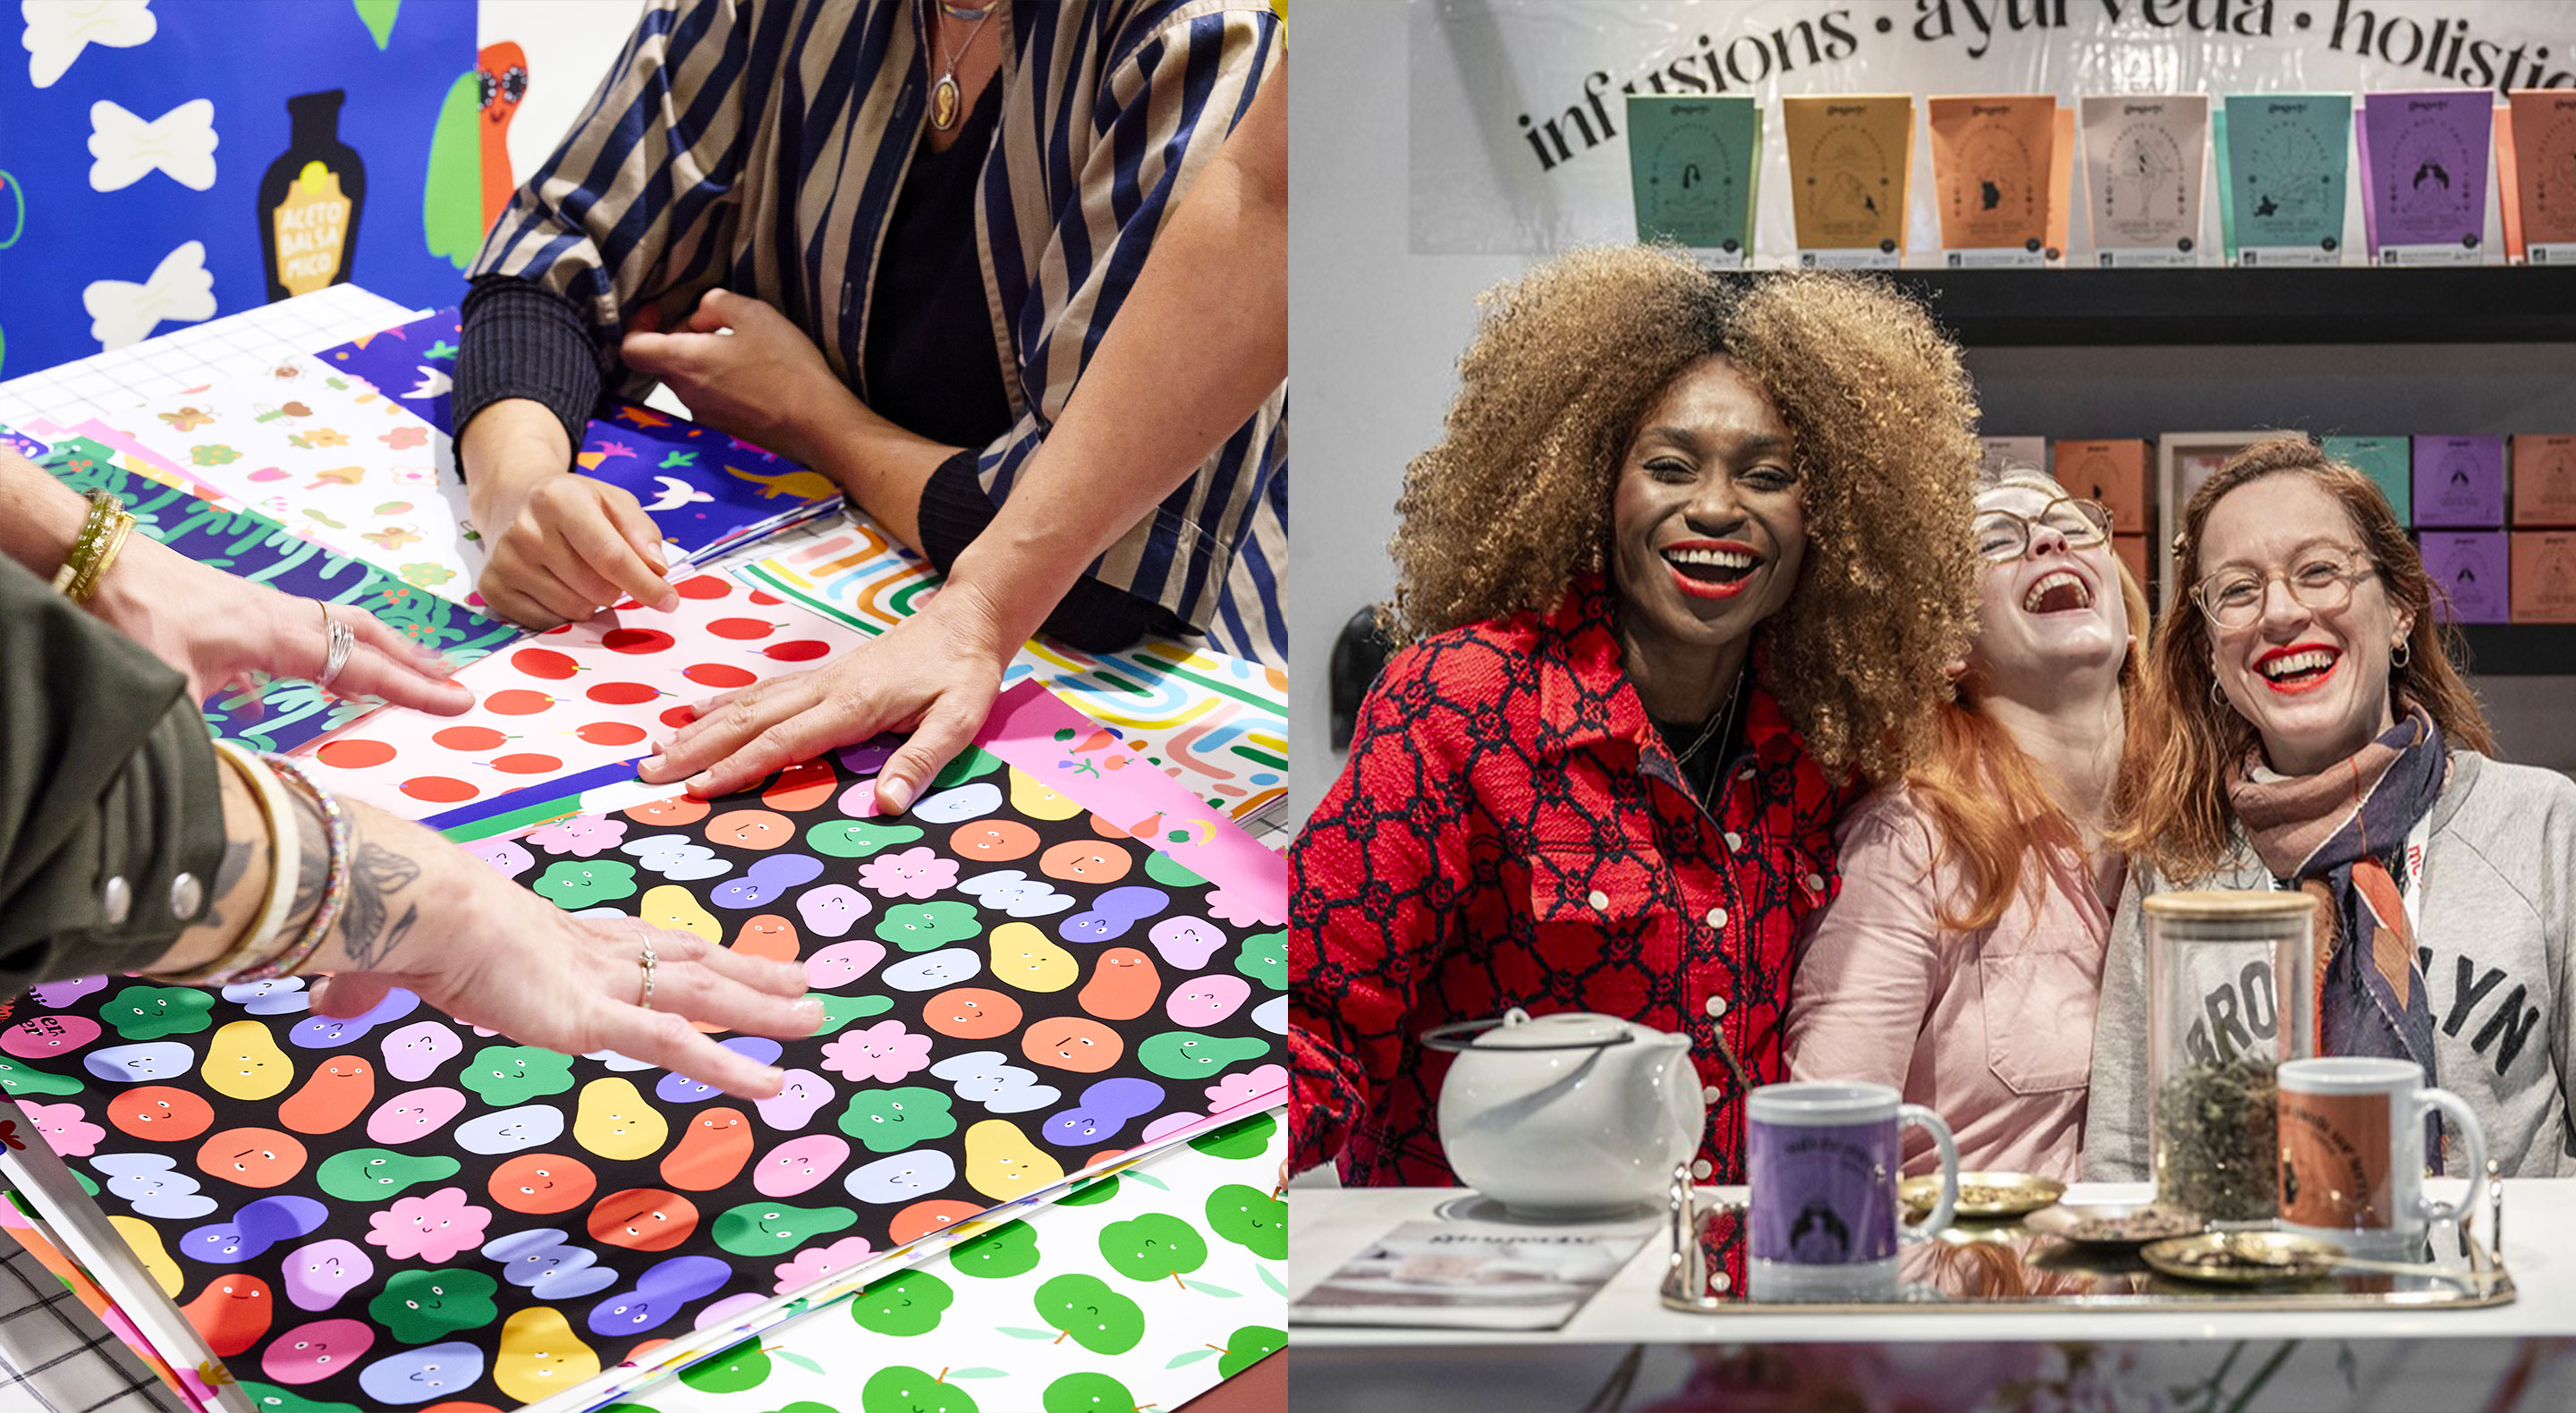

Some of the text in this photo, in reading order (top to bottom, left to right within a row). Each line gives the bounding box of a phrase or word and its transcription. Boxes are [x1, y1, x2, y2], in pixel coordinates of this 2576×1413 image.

[2328, 0, 2576, 97] holisti
[280, 202, 343, 233] ACETO
[281, 224, 339, 258] BALSA
[286, 251, 332, 280] MICO
